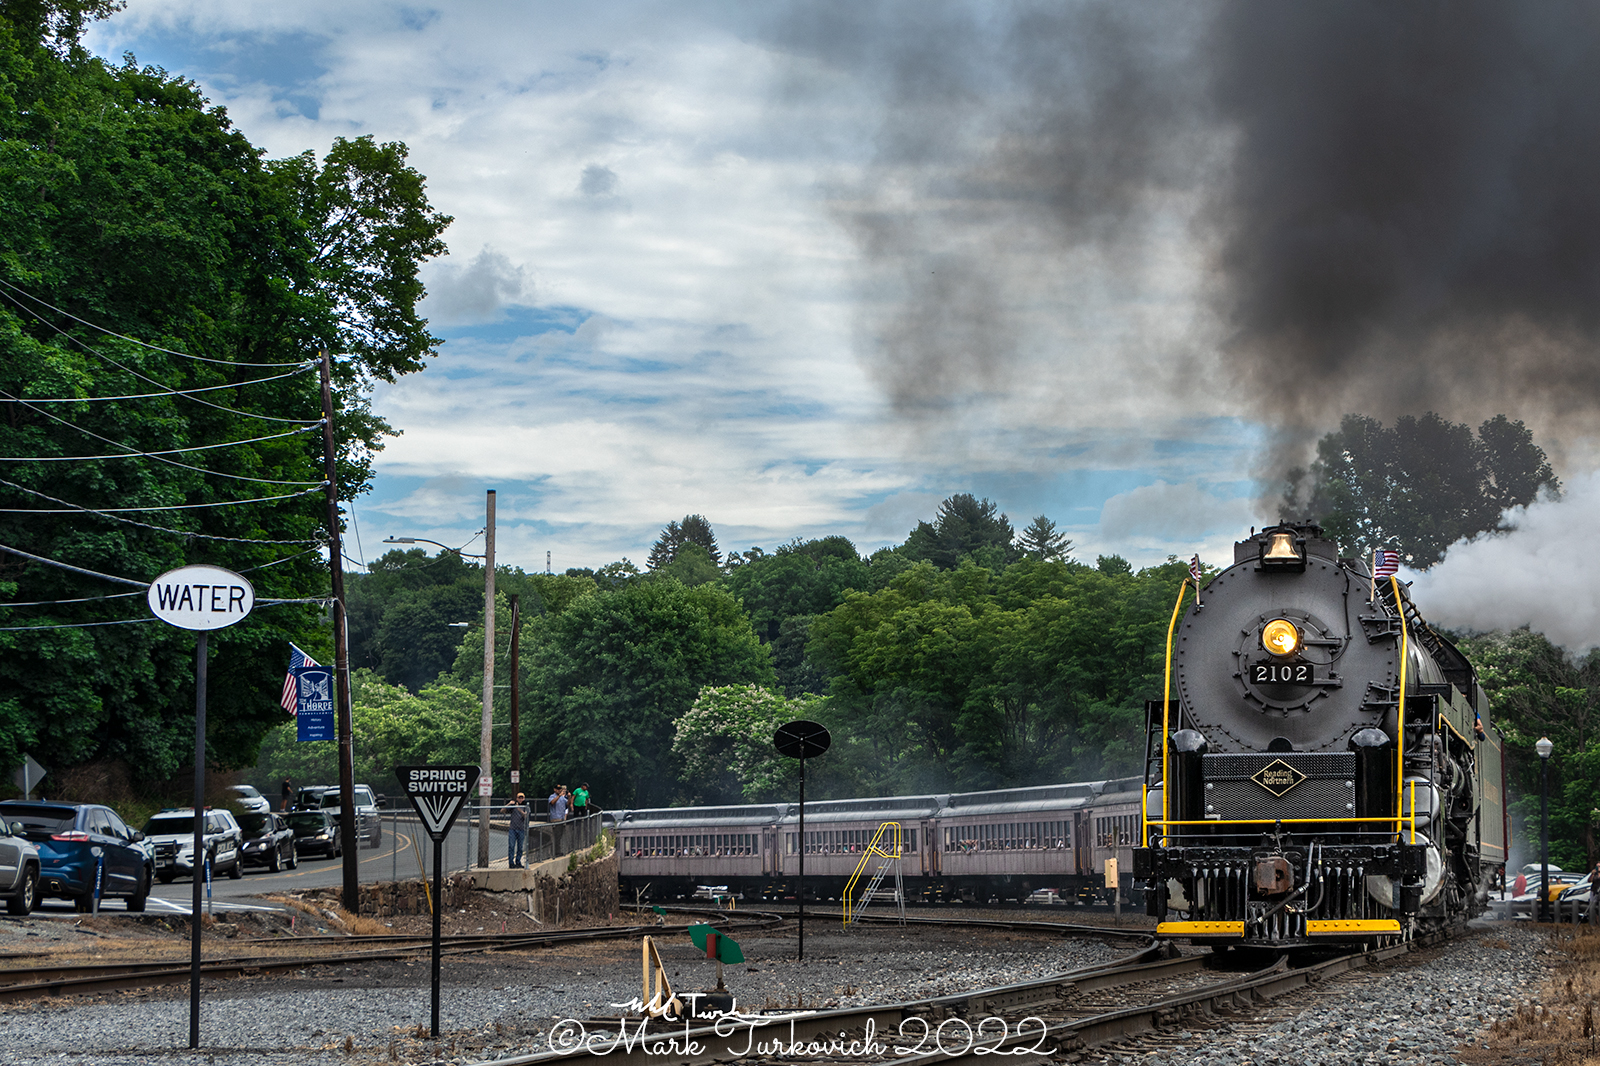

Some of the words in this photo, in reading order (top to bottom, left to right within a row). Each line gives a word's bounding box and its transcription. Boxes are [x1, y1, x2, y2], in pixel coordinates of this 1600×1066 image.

[157, 583, 246, 613] WATER
[1256, 665, 1307, 682] 2102
[300, 698, 333, 712] THORPE
[409, 770, 466, 780] SPRING
[1263, 769, 1293, 779] Reading
[1263, 777, 1294, 785] Northern
[408, 782, 467, 792] SWITCH
[217, 841, 234, 854] POLICE
